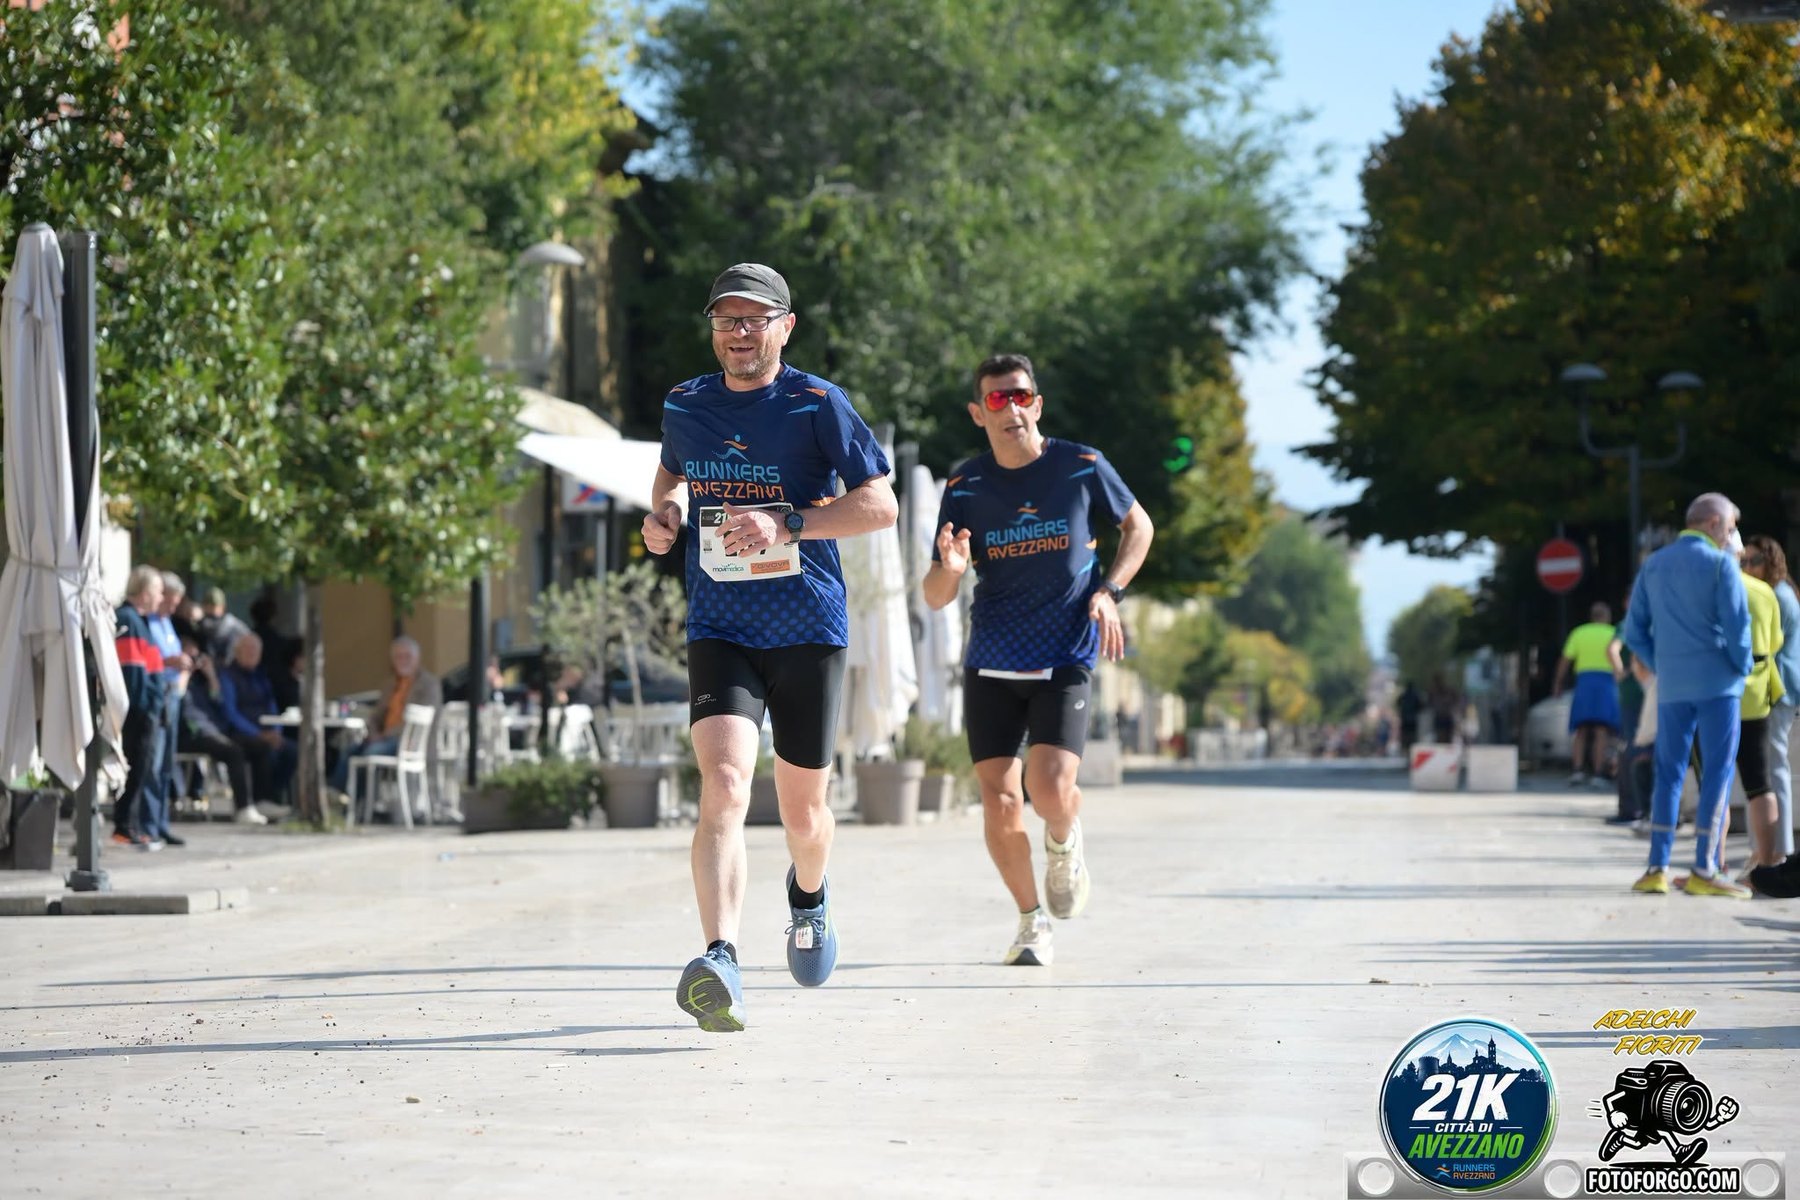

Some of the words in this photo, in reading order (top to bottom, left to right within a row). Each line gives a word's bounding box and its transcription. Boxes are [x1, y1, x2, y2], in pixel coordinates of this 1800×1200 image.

[685, 461, 781, 484] RUNNERS
[691, 481, 785, 501] AVEZZANO
[985, 519, 1069, 547] RUNNERS
[987, 535, 1069, 560] AVEZZANO
